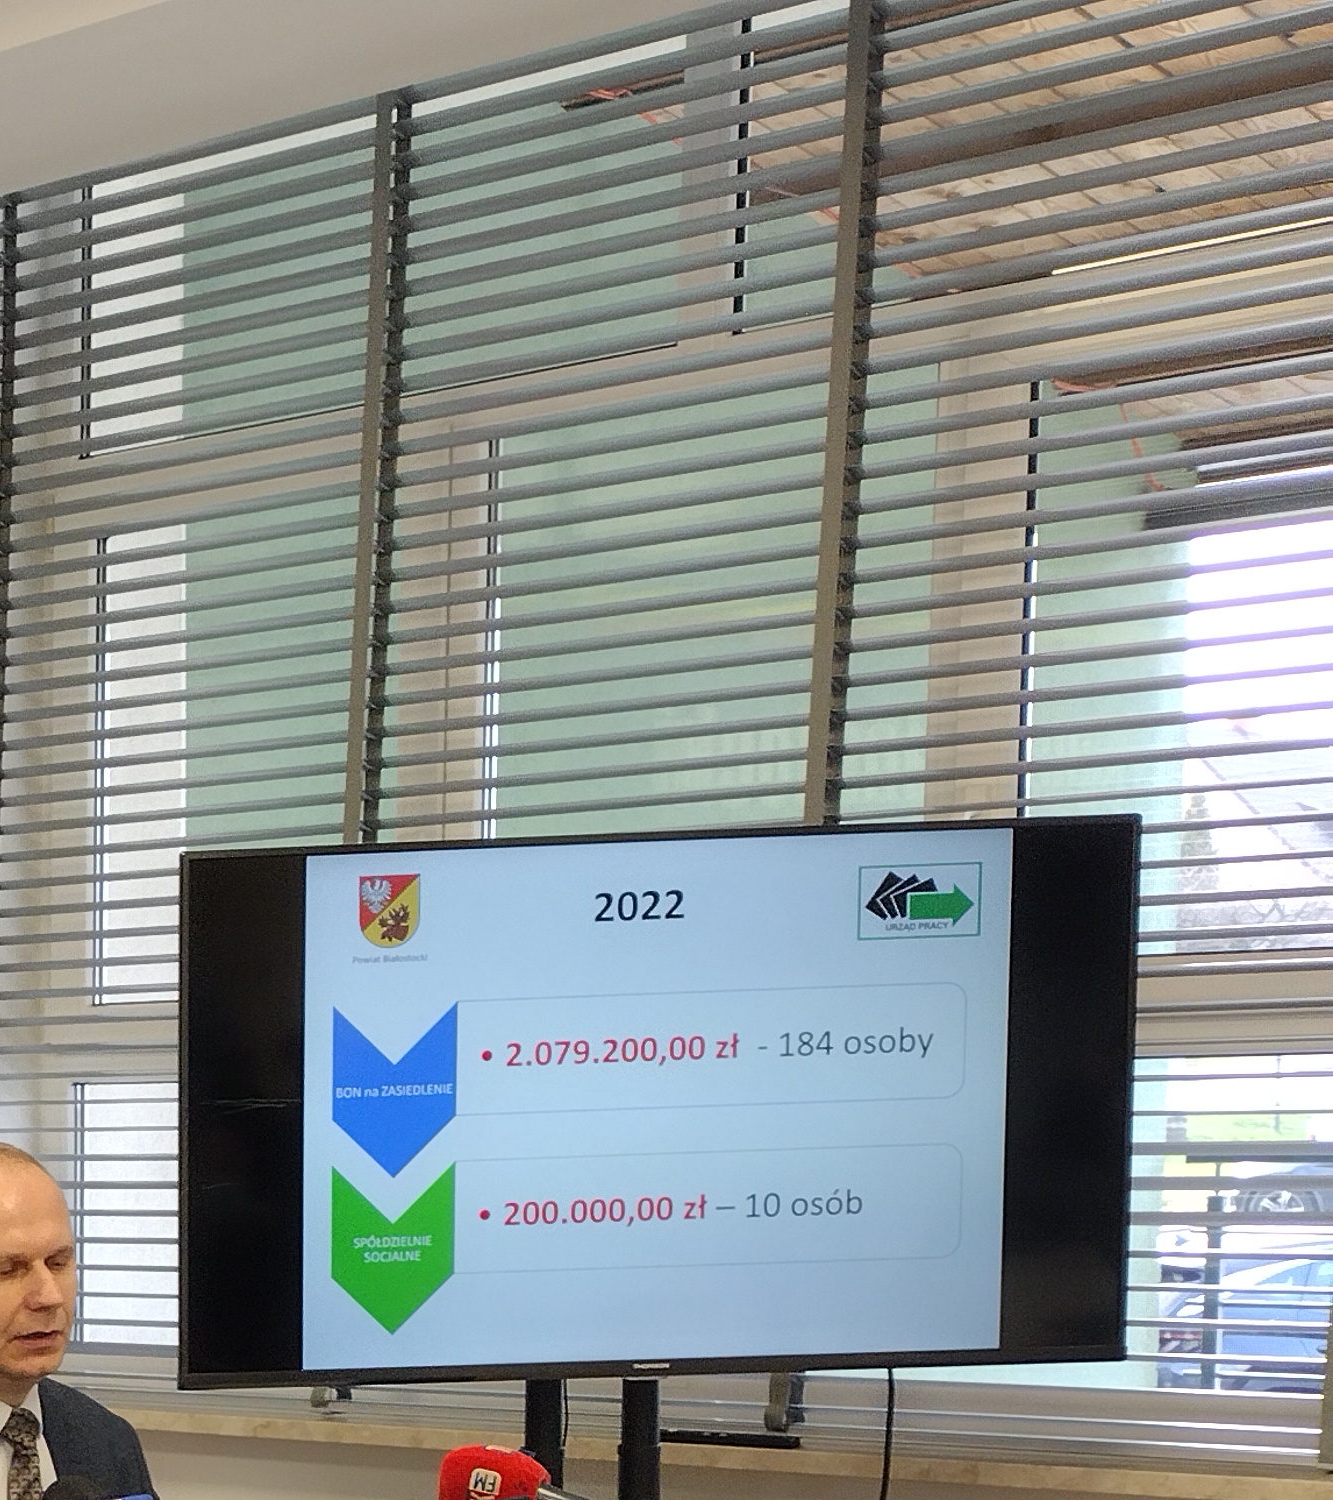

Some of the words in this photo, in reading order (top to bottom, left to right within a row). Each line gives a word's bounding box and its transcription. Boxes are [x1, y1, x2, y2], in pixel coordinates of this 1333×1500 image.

[594, 889, 685, 922] 2022
[918, 922, 949, 930] PRACY
[352, 956, 381, 964] Powiat
[505, 1034, 706, 1068] 2.079.200,00
[716, 1032, 740, 1059] zł
[779, 1030, 834, 1058] 184
[844, 1027, 934, 1059] osoby
[335, 1086, 362, 1099] BON
[364, 1087, 379, 1097] na
[381, 1083, 454, 1097] ZASIEDLENIE
[504, 1196, 673, 1227] 200.000,00
[683, 1193, 708, 1220] zł
[745, 1192, 781, 1218] 10
[791, 1188, 863, 1217] osób
[352, 1234, 433, 1249] SPÓŁDZIELNIE
